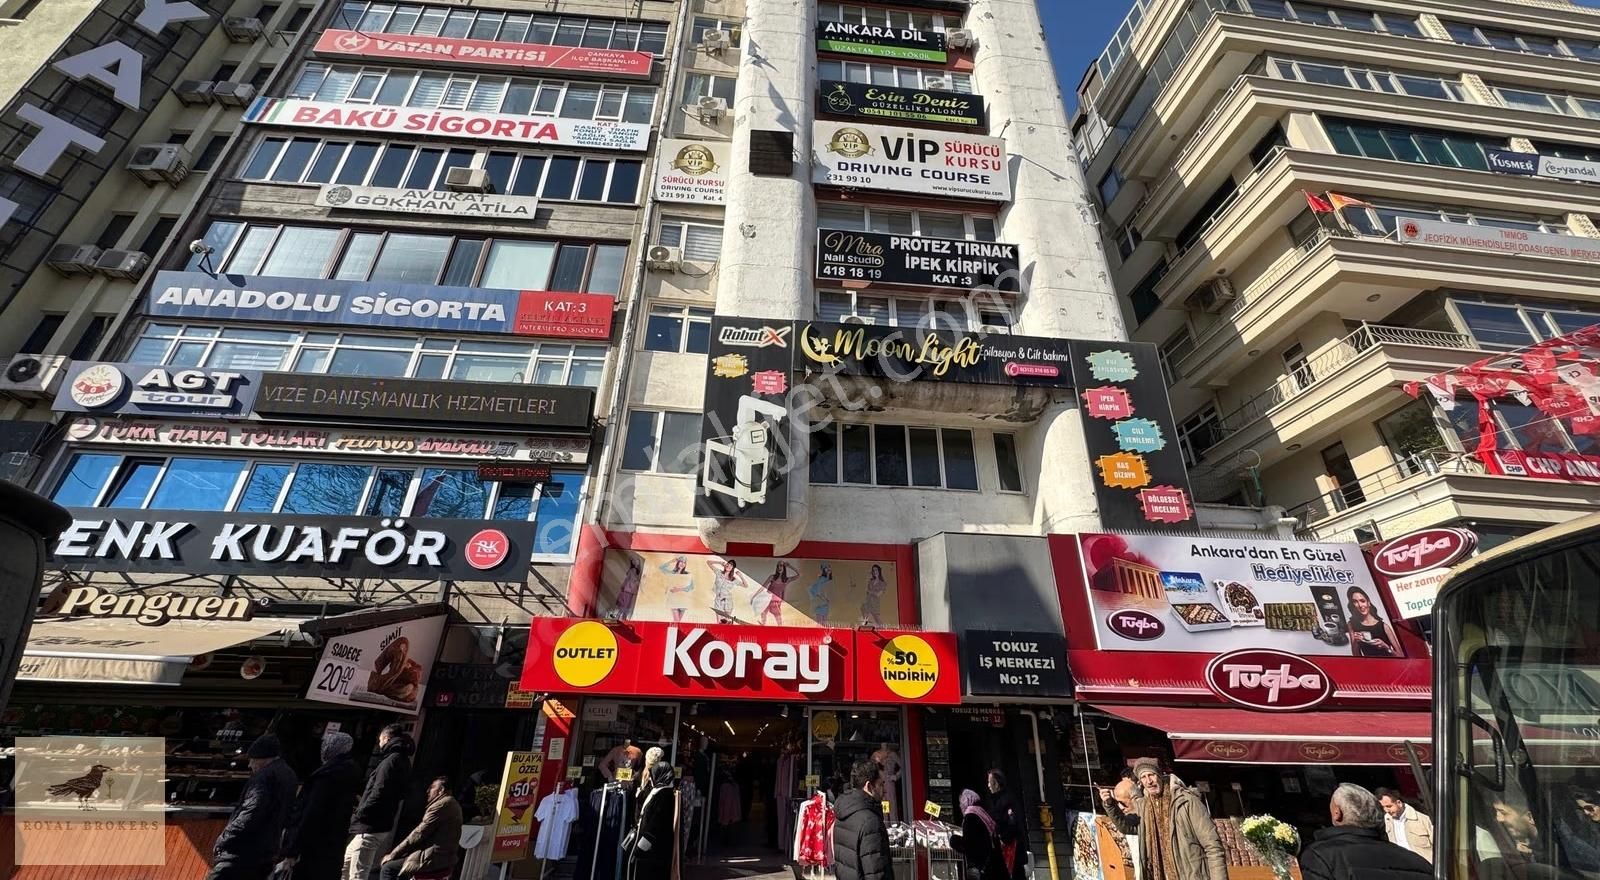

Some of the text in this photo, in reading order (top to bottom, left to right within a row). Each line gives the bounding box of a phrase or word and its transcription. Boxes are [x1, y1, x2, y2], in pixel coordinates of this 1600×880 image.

[824, 22, 927, 42] ANKARA DİL
[375, 38, 546, 62] VATAN PARTİSİ
[834, 45, 874, 54] UZAKTAN
[865, 88, 906, 102] Esin
[913, 92, 970, 109] Deniz
[872, 102, 964, 116] GÜZELLİK SALONU
[291, 106, 560, 142] BAKÜ SİGORTA
[880, 132, 940, 163] VİP
[944, 140, 1000, 158] SÜRÜCÜ
[838, 161, 990, 184] DRIVING COURSE
[946, 156, 1000, 171] KURSU
[661, 184, 691, 192] DRIVING
[662, 175, 724, 187] SÜRÜCÜ KURSU
[826, 174, 843, 182] 231
[860, 176, 872, 184] 10
[354, 194, 454, 210] GÖKHAN
[466, 202, 528, 214] ATİLA
[403, 190, 489, 202] AVUKAT
[824, 232, 884, 255] Mira
[890, 236, 1013, 259] PROTEZ TIRNAK
[824, 266, 882, 279] 418 18 19
[906, 253, 1000, 276] İPEK KİRPİK
[932, 274, 958, 284] KAT
[156, 286, 506, 322] ANADOLU SİGORTA
[834, 327, 982, 376] Moon Light
[1018, 347, 1025, 360] &
[137, 368, 241, 391] AGT
[143, 392, 223, 404] tour
[100, 420, 158, 441] TÜRK
[168, 426, 230, 445] HAVA
[240, 427, 331, 448] YOLLARI
[1526, 456, 1562, 474] CHP
[210, 518, 446, 567] KUAFÖR
[1190, 544, 1346, 564] Ankara'dan En Güzel
[1252, 564, 1354, 585] Hediyelikler
[1396, 574, 1446, 593] Her zama
[56, 586, 252, 626] Penguen
[1405, 596, 1437, 611] Tapta
[331, 642, 362, 662] SADECE
[556, 646, 615, 660] OUTLET
[992, 641, 1038, 653] TOKUZ
[663, 626, 830, 693] Koray
[886, 650, 918, 666] %50
[979, 654, 1056, 670] İŞ MERKEZİ
[317, 662, 343, 692] 20
[884, 667, 936, 682] İNDİRİM
[1000, 672, 1040, 686] No: 12
[338, 680, 348, 696] TL
[512, 754, 526, 762] BU
[518, 763, 540, 774] ÖZEL
[502, 840, 521, 848] Koray
